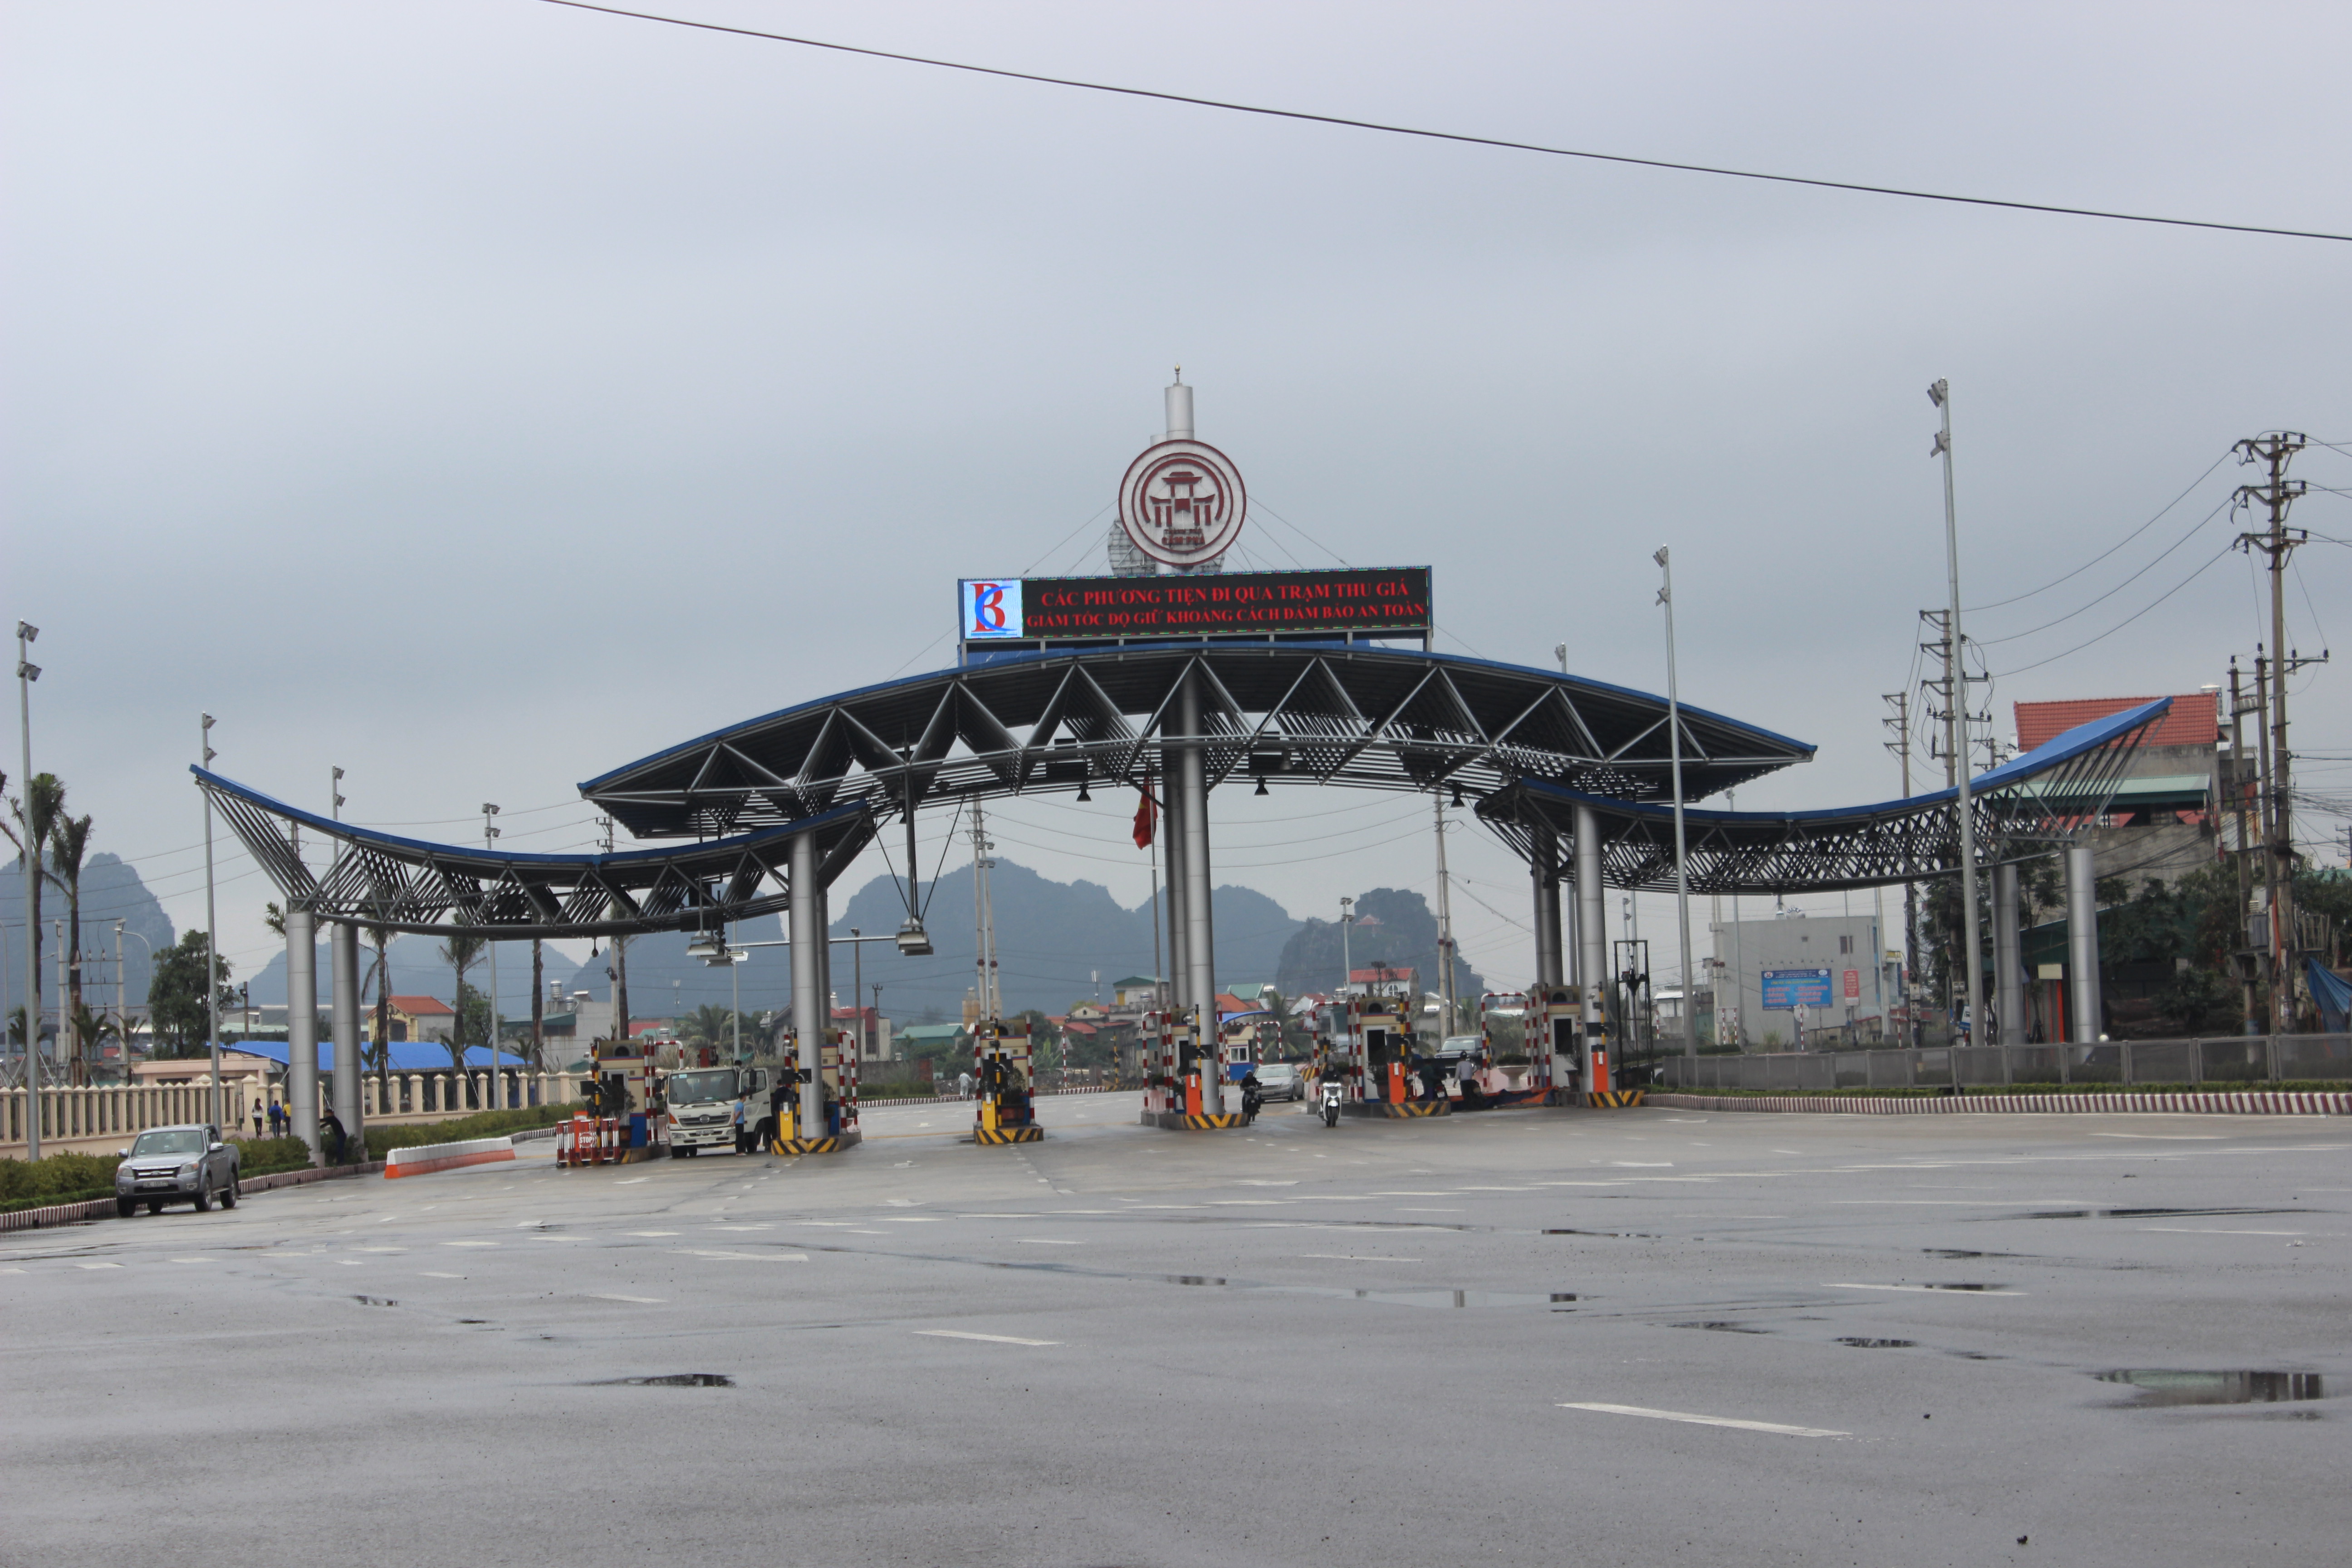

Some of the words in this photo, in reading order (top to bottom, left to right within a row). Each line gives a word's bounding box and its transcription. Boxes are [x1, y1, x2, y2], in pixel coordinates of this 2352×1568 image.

[1041, 588, 1079, 607] CÁC
[1083, 588, 1161, 606] PHƯƠNG
[1165, 586, 1207, 606] TIỆN
[1211, 587, 1231, 602] ĐI
[1234, 586, 1274, 604] QUA
[1277, 583, 1331, 603] TRẠM
[1333, 583, 1372, 598] THU
[1375, 578, 1409, 597] GIÁ
[1026, 612, 1069, 627] GIẢM
[1072, 610, 1104, 626] TỐC
[1166, 607, 1234, 623] KHOẢNG
[1235, 605, 1280, 621] CÁCH
[1322, 603, 1355, 619] BẢO
[1357, 604, 1379, 617] AN
[1382, 600, 1425, 617] TOÀN
